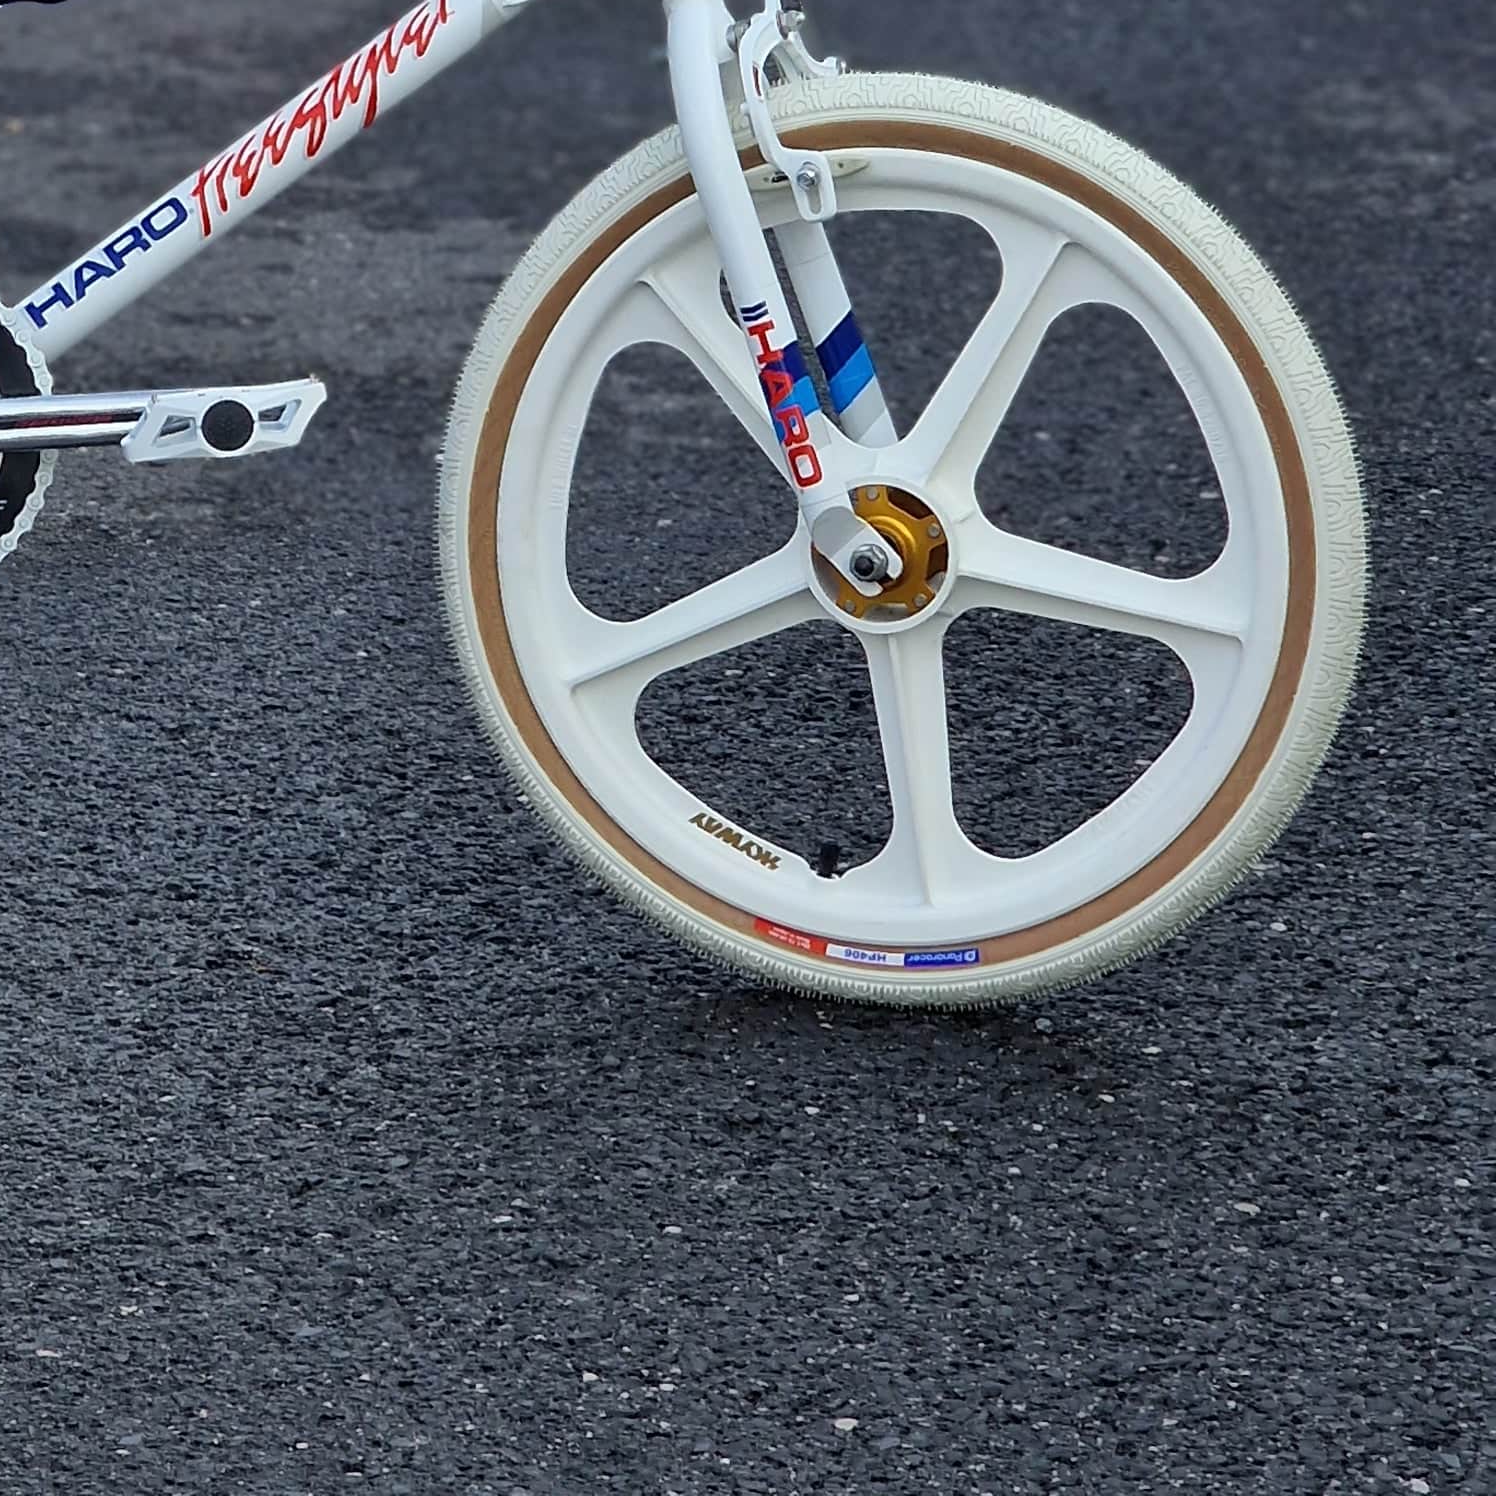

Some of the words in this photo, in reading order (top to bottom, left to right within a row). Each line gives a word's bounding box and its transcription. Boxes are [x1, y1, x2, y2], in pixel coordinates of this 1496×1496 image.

[23, 196, 189, 329] HARO
[747, 319, 824, 488] HARO
[687, 811, 784, 871] SKYWAY
[843, 947, 888, 963] HP406
